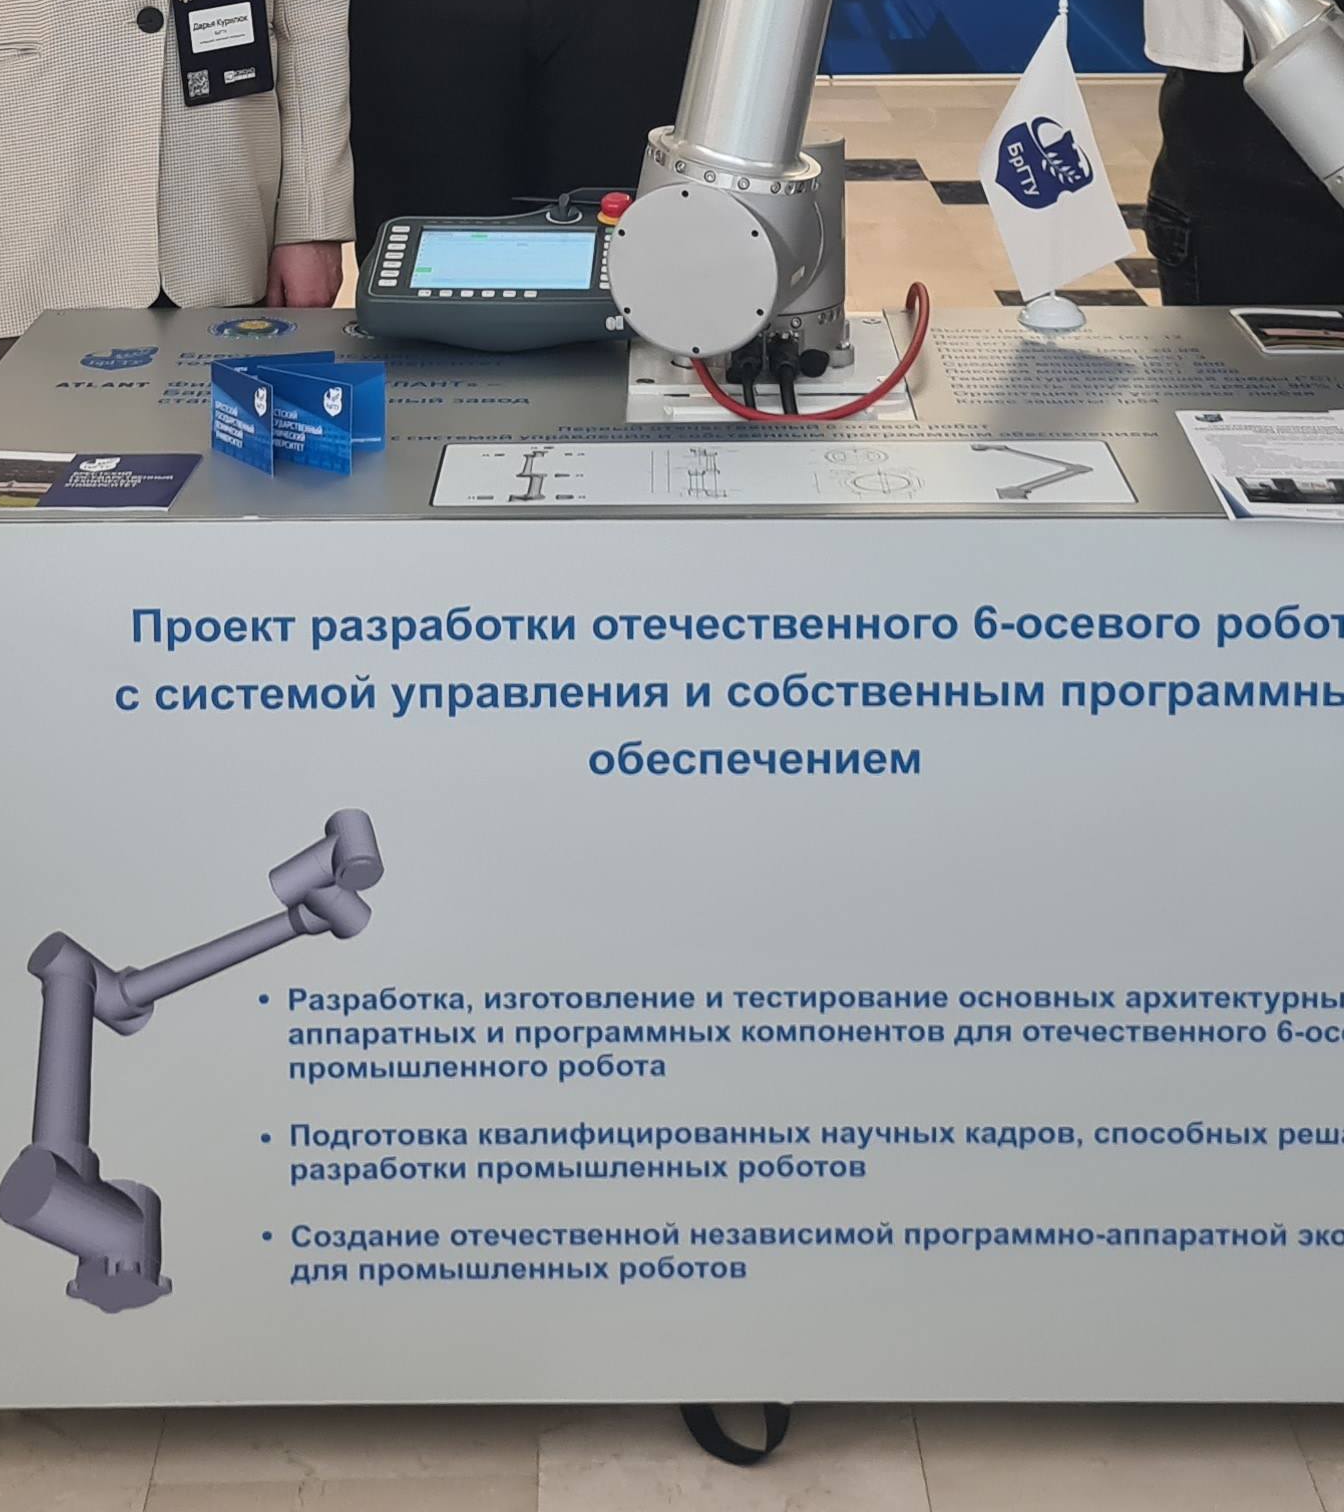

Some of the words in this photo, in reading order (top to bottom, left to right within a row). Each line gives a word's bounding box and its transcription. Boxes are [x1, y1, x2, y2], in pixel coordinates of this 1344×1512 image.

[1007, 141, 1042, 197] БрГТУ
[131, 607, 297, 654] Проект
[311, 604, 577, 652] разработки
[592, 612, 960, 648] отечественного
[973, 604, 1202, 648] 6-осевого
[115, 684, 142, 712] с
[155, 675, 377, 712] системой
[390, 680, 672, 721] управления
[683, 682, 713, 711] и
[726, 671, 1047, 711] собственным
[587, 740, 922, 776] обеспечением
[288, 988, 471, 1017] Разработка,
[484, 990, 696, 1012] изготовление
[704, 992, 725, 1008] и
[735, 990, 949, 1015] тестирование
[959, 990, 1115, 1011] основных
[288, 1027, 476, 1049] аппаратных
[485, 1027, 505, 1044] и
[513, 1025, 731, 1049] программных
[740, 1025, 946, 1045] компонентов
[953, 1024, 1013, 1048] для
[1022, 1024, 1268, 1045] отечественного
[290, 1059, 549, 1084] промышленного
[558, 1055, 668, 1083] робота
[290, 1123, 468, 1149] Подготовка
[479, 1123, 810, 1150] квалифицированных
[821, 1128, 955, 1150] научных
[965, 1127, 1080, 1150] кадров,
[1094, 1123, 1267, 1145] способных
[290, 1157, 468, 1186] разработки
[476, 1160, 728, 1183] промышленных
[737, 1156, 867, 1183] роботов
[292, 1225, 441, 1251] Создание
[449, 1222, 681, 1246] отечественной
[691, 1221, 895, 1246] независимой
[904, 1222, 1288, 1251] программно-аппаратной
[290, 1264, 348, 1284] для
[358, 1263, 608, 1287] промышленных
[619, 1257, 748, 1283] роботов
